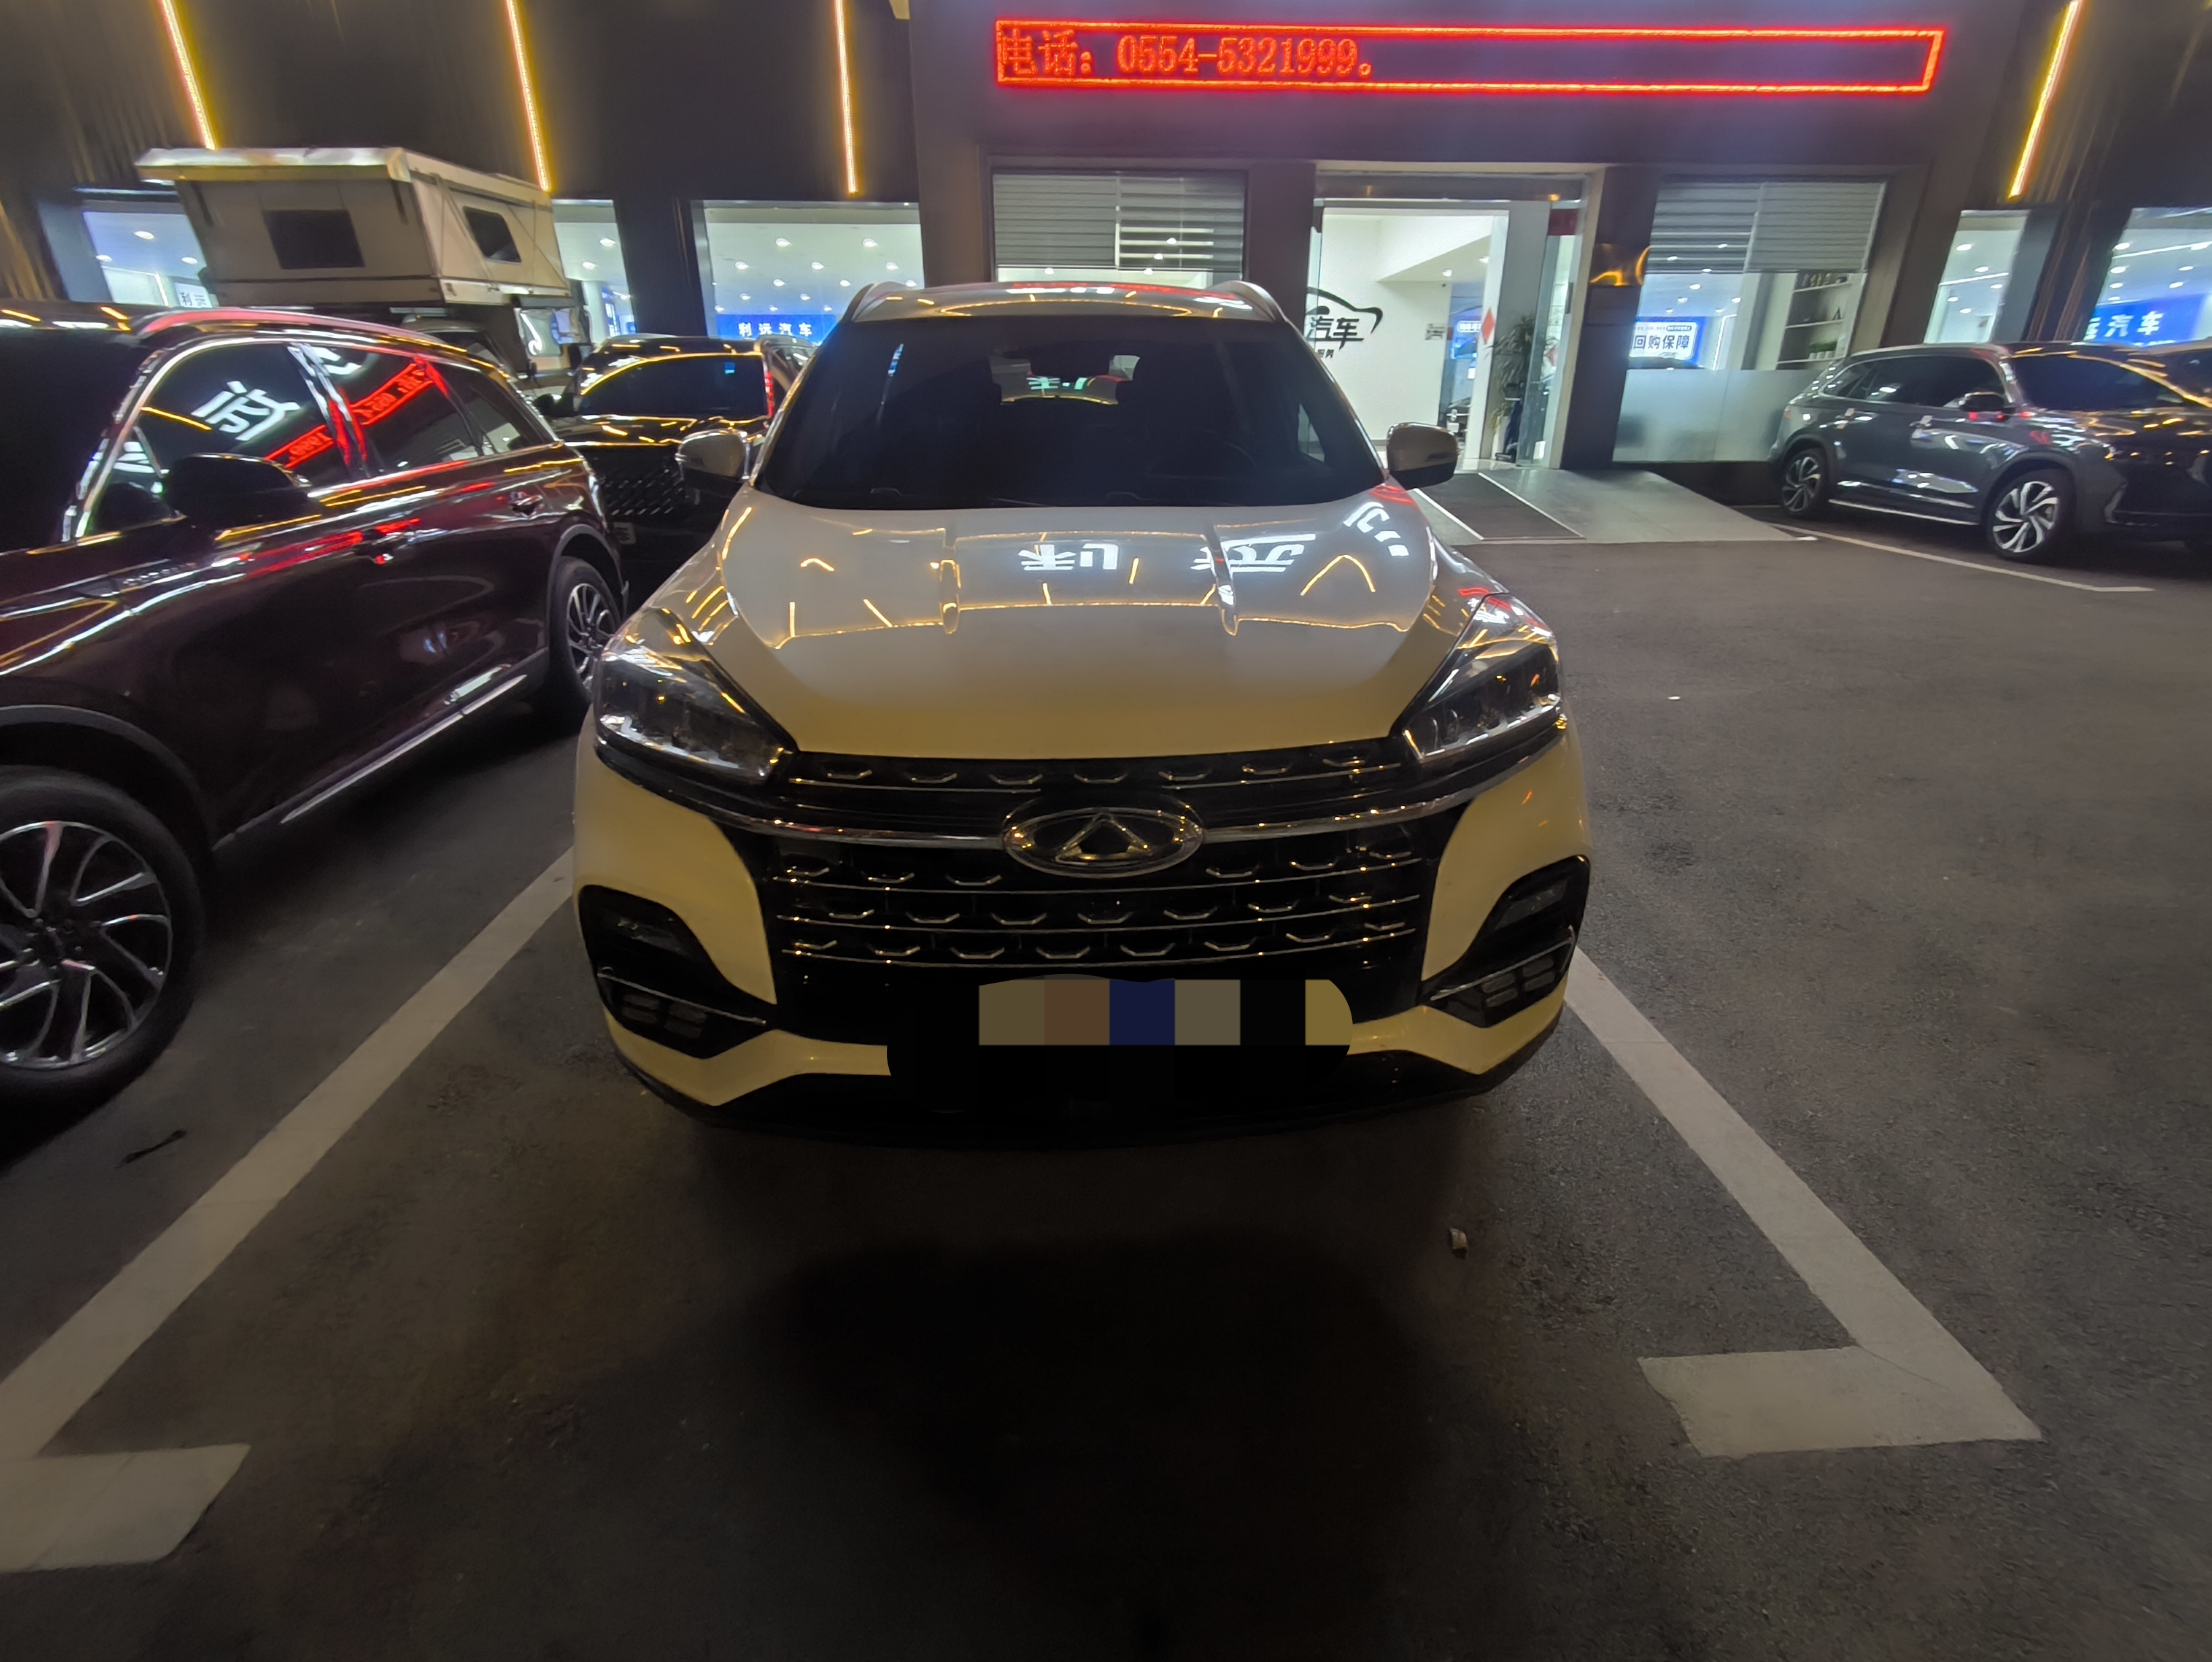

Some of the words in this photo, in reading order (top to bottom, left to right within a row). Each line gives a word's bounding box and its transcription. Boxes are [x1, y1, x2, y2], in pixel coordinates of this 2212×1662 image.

[738, 322, 813, 337] 利远汽车
[1633, 335, 1690, 349] 回购保障
